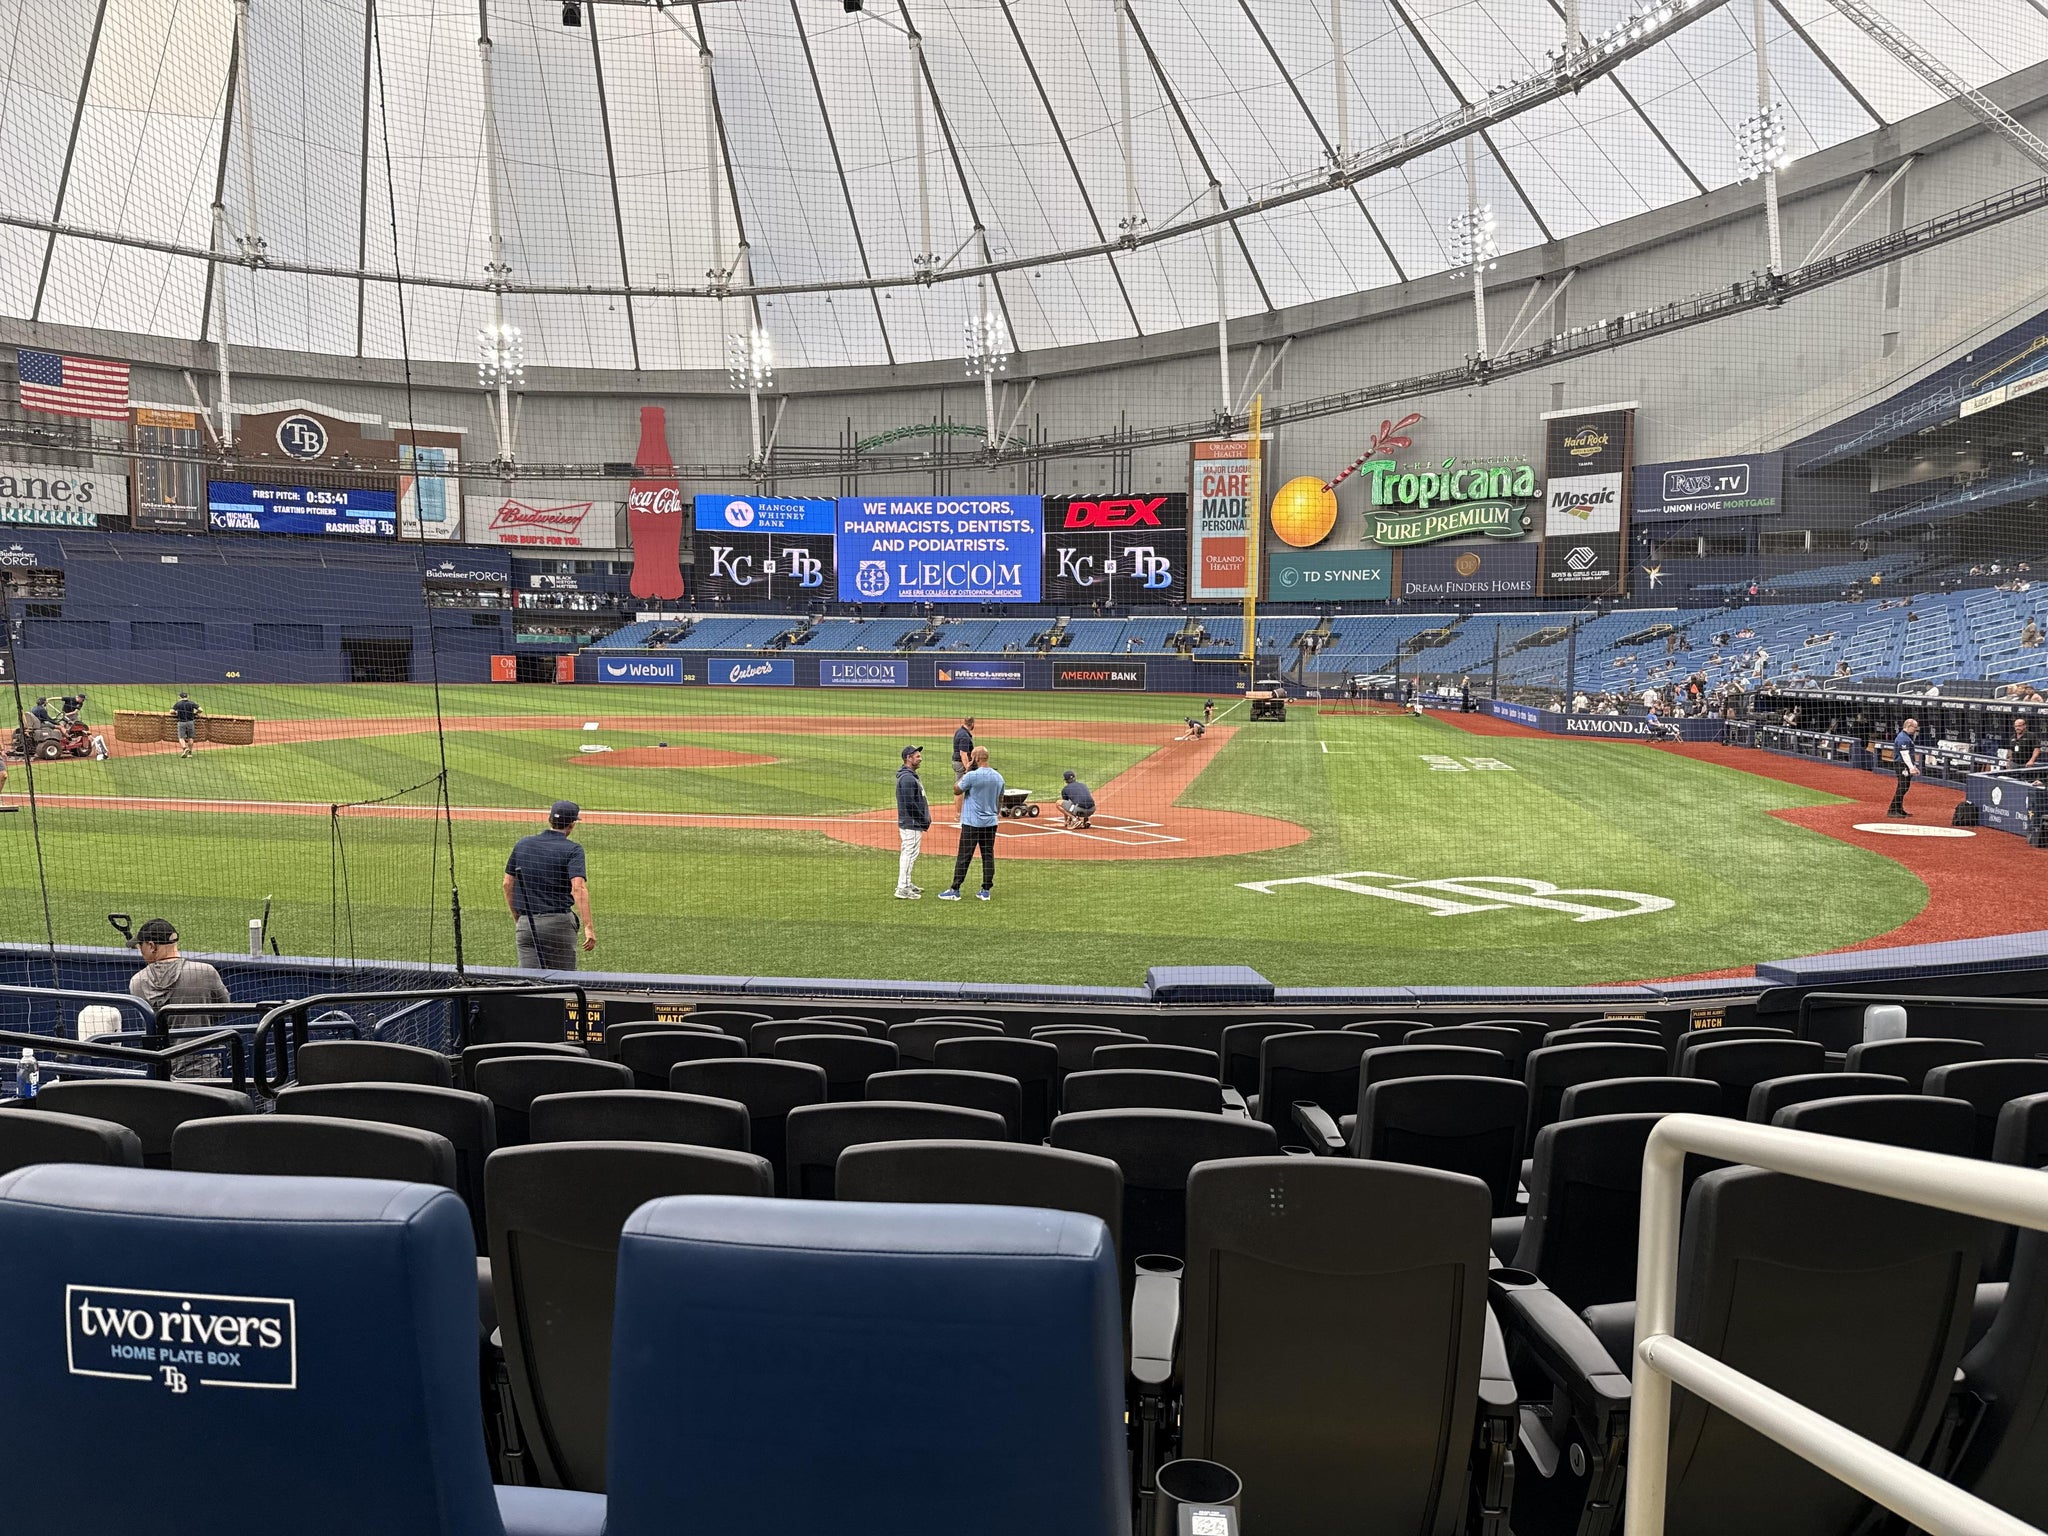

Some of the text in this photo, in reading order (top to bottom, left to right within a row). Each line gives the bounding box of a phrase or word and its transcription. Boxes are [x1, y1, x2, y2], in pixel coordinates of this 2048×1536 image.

[286, 423, 320, 452] TB
[1564, 433, 1609, 447] Hard Rock
[1214, 450, 1244, 458] HEALTH
[1203, 466, 1226, 474] MAJOR
[1202, 475, 1250, 497] CARE
[1360, 457, 1535, 508] Tropicana
[1671, 475, 1740, 494] RAYS .TV
[253, 490, 348, 504] FIRST PITCH: 0:53:41
[629, 487, 682, 514] Coca-Cola
[1552, 487, 1615, 508] Mosaic
[273, 506, 336, 516] STARTING PITCHERS
[758, 504, 805, 512] HANCOCK
[864, 502, 1014, 516] WE MAKE DOCTORS,
[1202, 498, 1250, 518] MADE
[1663, 504, 1692, 513] UNION
[1694, 502, 1721, 511] HOME
[1723, 498, 1775, 508] MORTGAGE
[498, 506, 582, 525] Budweiser
[758, 512, 805, 520] WHITNEY
[1064, 498, 1168, 528] DEX
[227, 518, 260, 529] WACHA
[326, 523, 376, 534] RASMUSSEN
[758, 520, 785, 528] BANK
[844, 520, 1034, 534] PHARMACISTS, DENTISTS,
[1376, 508, 1509, 540] PURE PREMIUM
[500, 534, 582, 546] THIS BUD'S FOR YOU.
[872, 539, 1009, 552] AND PODIATRISTS.
[0, 557, 38, 566] ORCH
[710, 546, 752, 586] KC
[782, 548, 823, 588] TB
[1057, 548, 1094, 586] KC
[1124, 546, 1172, 588] TB
[426, 570, 508, 582] Budweiser PORCH
[1304, 569, 1380, 582] TD SYNNEX
[1406, 580, 1531, 594] DREAM FINDERS HOMES
[630, 663, 674, 677] Webull
[729, 662, 773, 684] Culver's
[955, 670, 1020, 678] MicroLumen
[1061, 672, 1136, 681] AMERANT BANK
[1566, 719, 1680, 734] RAYMOND JAES
[1234, 870, 1676, 922] TB
[568, 1010, 600, 1021] WCH
[658, 1014, 684, 1023] WATC
[1694, 1018, 1722, 1028] WATCH
[79, 1297, 282, 1348] two rivers
[111, 1345, 241, 1366] HOME PLATE BOX
[160, 1365, 188, 1393] TB
